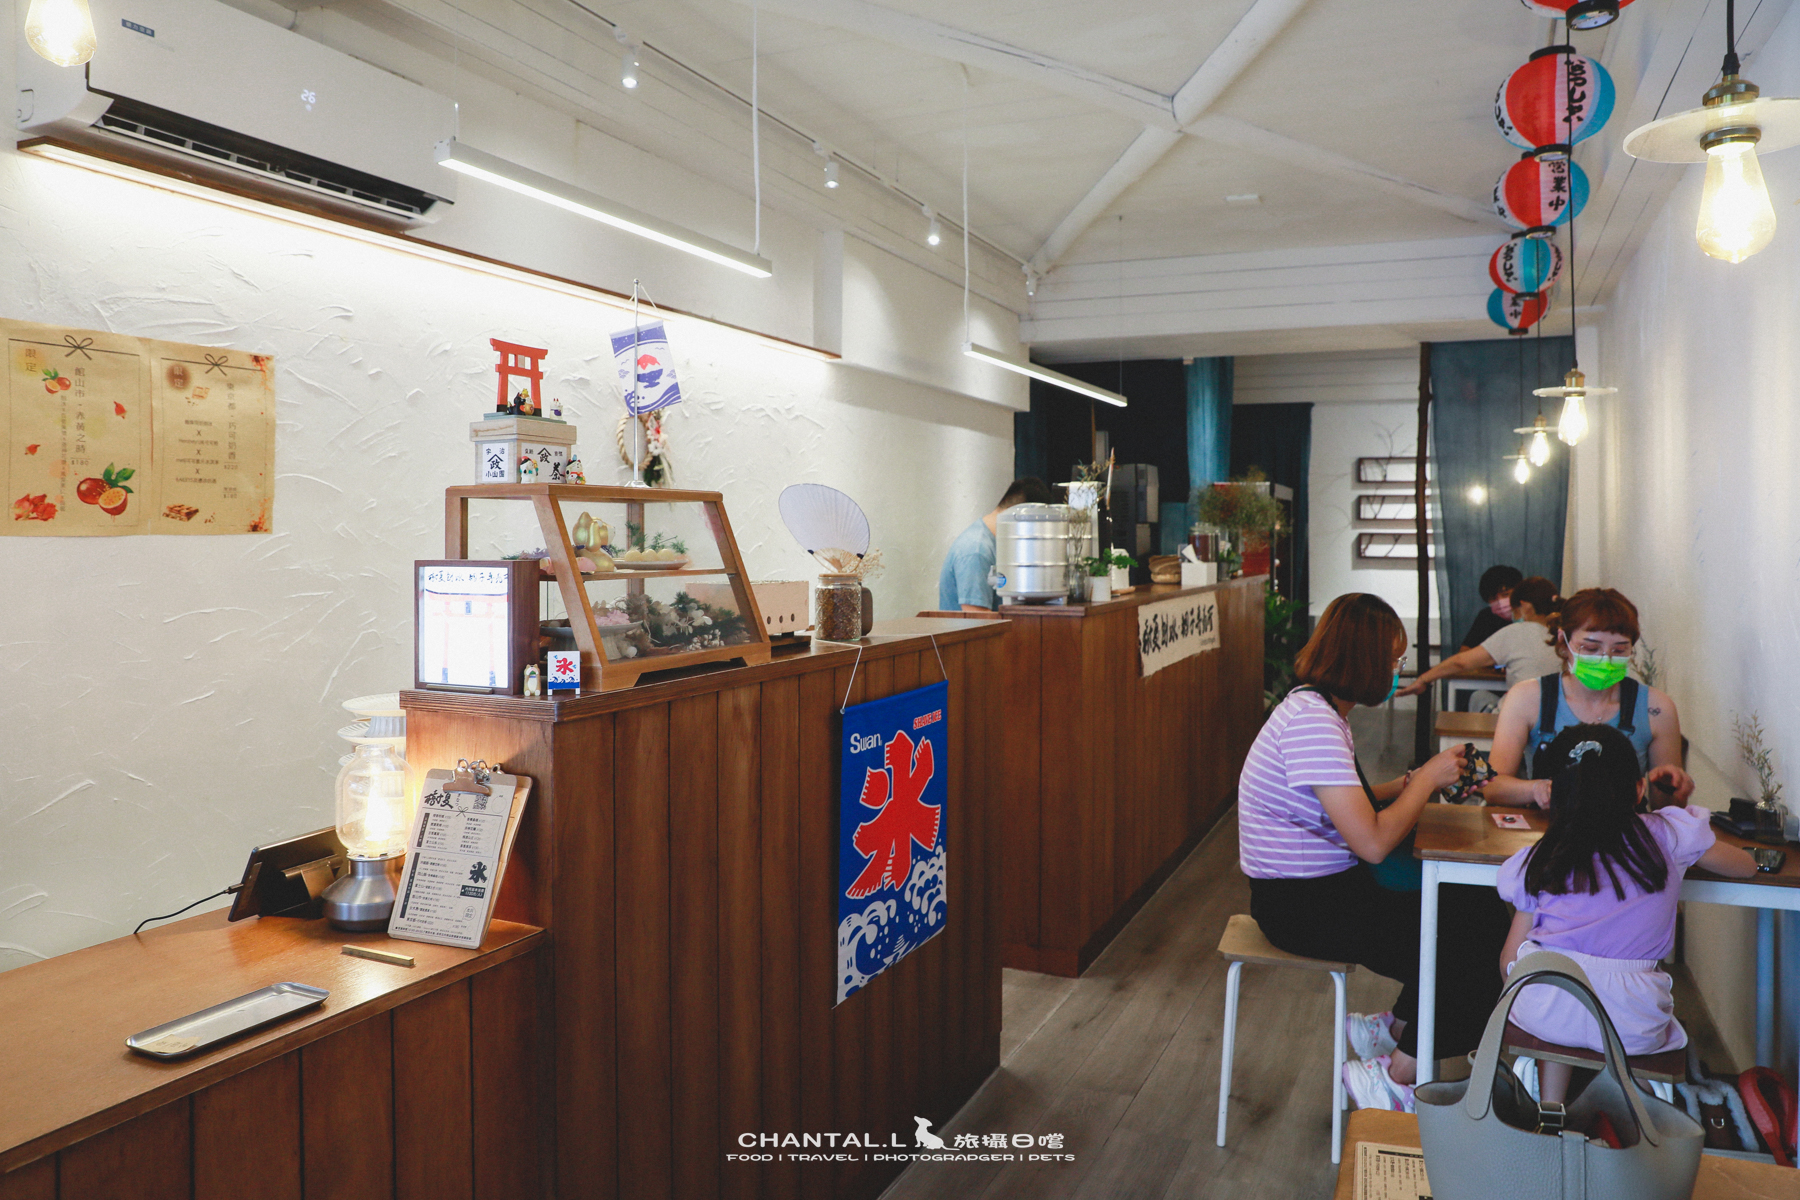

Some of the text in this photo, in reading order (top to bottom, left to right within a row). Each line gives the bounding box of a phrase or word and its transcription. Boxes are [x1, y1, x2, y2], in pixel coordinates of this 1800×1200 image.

[301, 89, 316, 104] 26
[25, 348, 37, 373] 限定
[173, 366, 184, 388] 限定
[555, 657, 575, 675] 氷
[913, 709, 942, 730] SHAVE ICE
[850, 732, 881, 754] Swan
[845, 729, 941, 899] 氷
[467, 861, 488, 884] 氷
